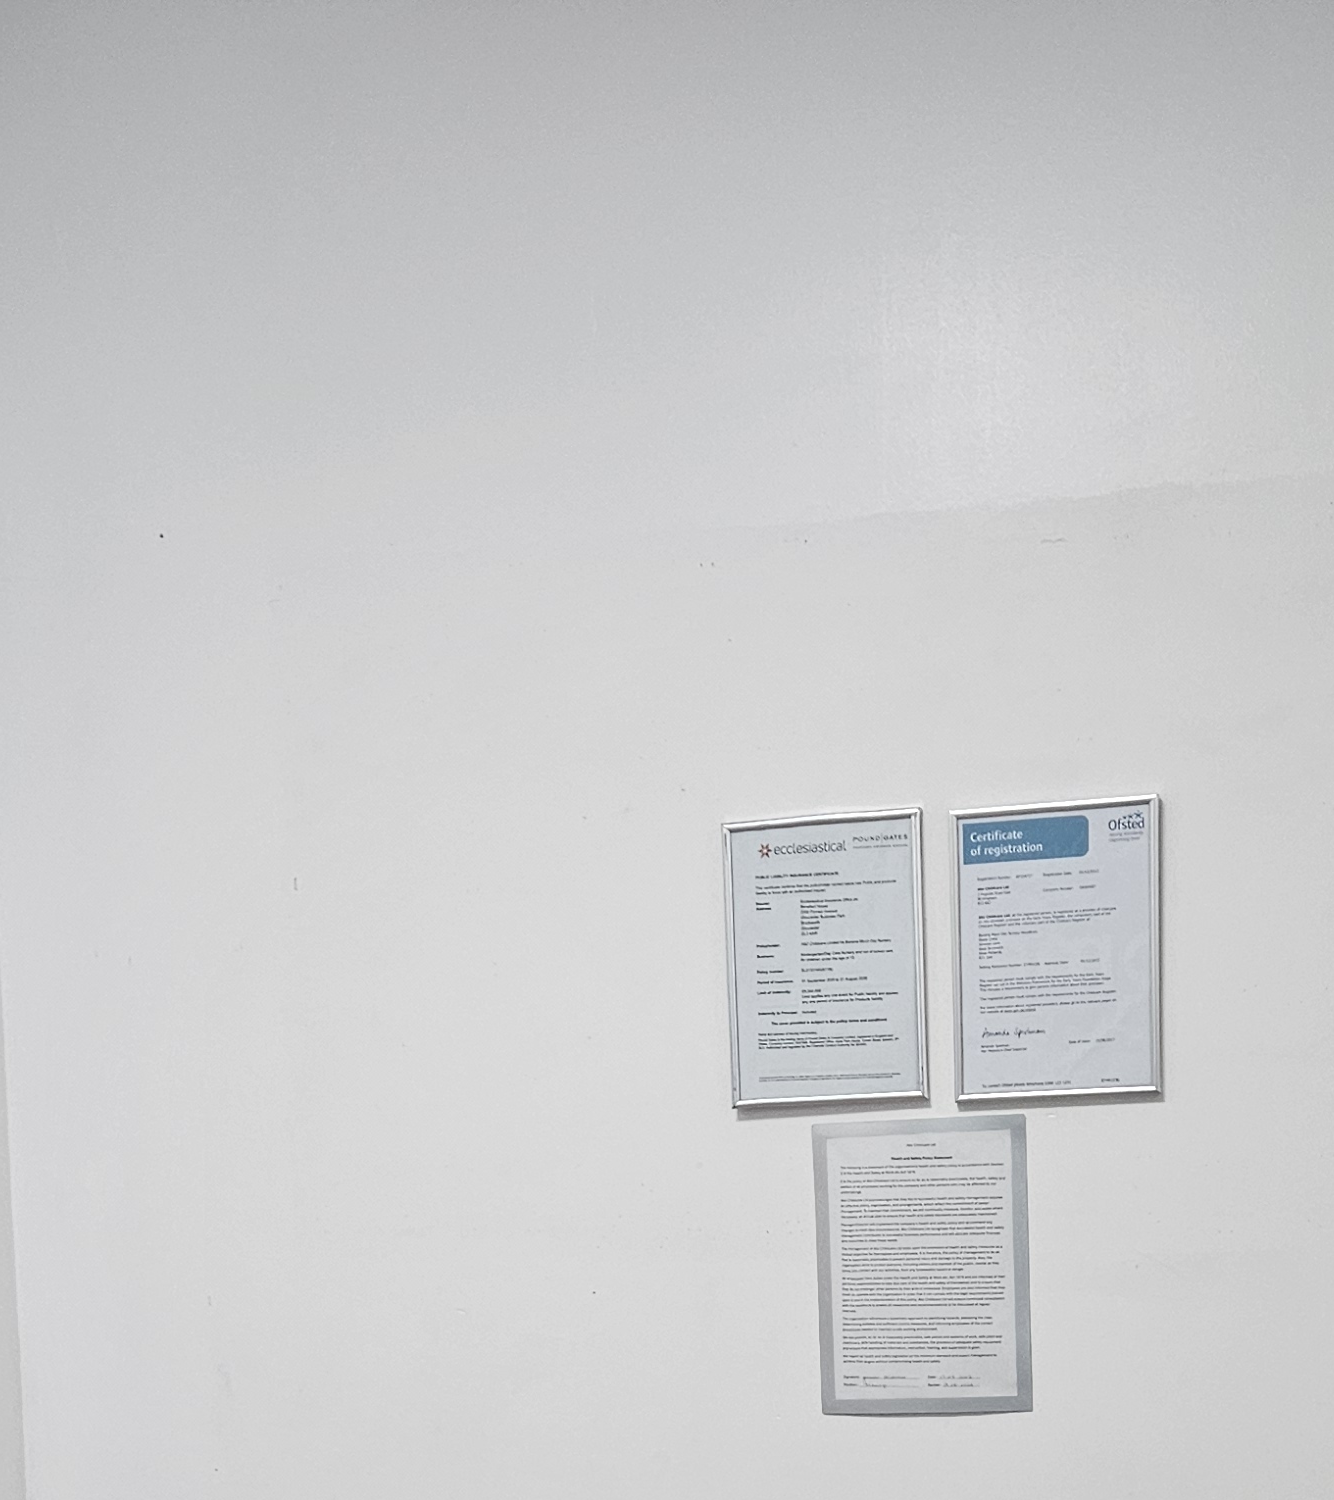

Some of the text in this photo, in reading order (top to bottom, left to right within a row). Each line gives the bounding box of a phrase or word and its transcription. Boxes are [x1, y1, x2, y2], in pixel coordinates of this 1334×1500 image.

[1108, 817, 1145, 831] Ofsted
[970, 829, 1023, 843] Certificate
[773, 840, 847, 855] ecclesiastical
[970, 841, 1043, 857] of registration
